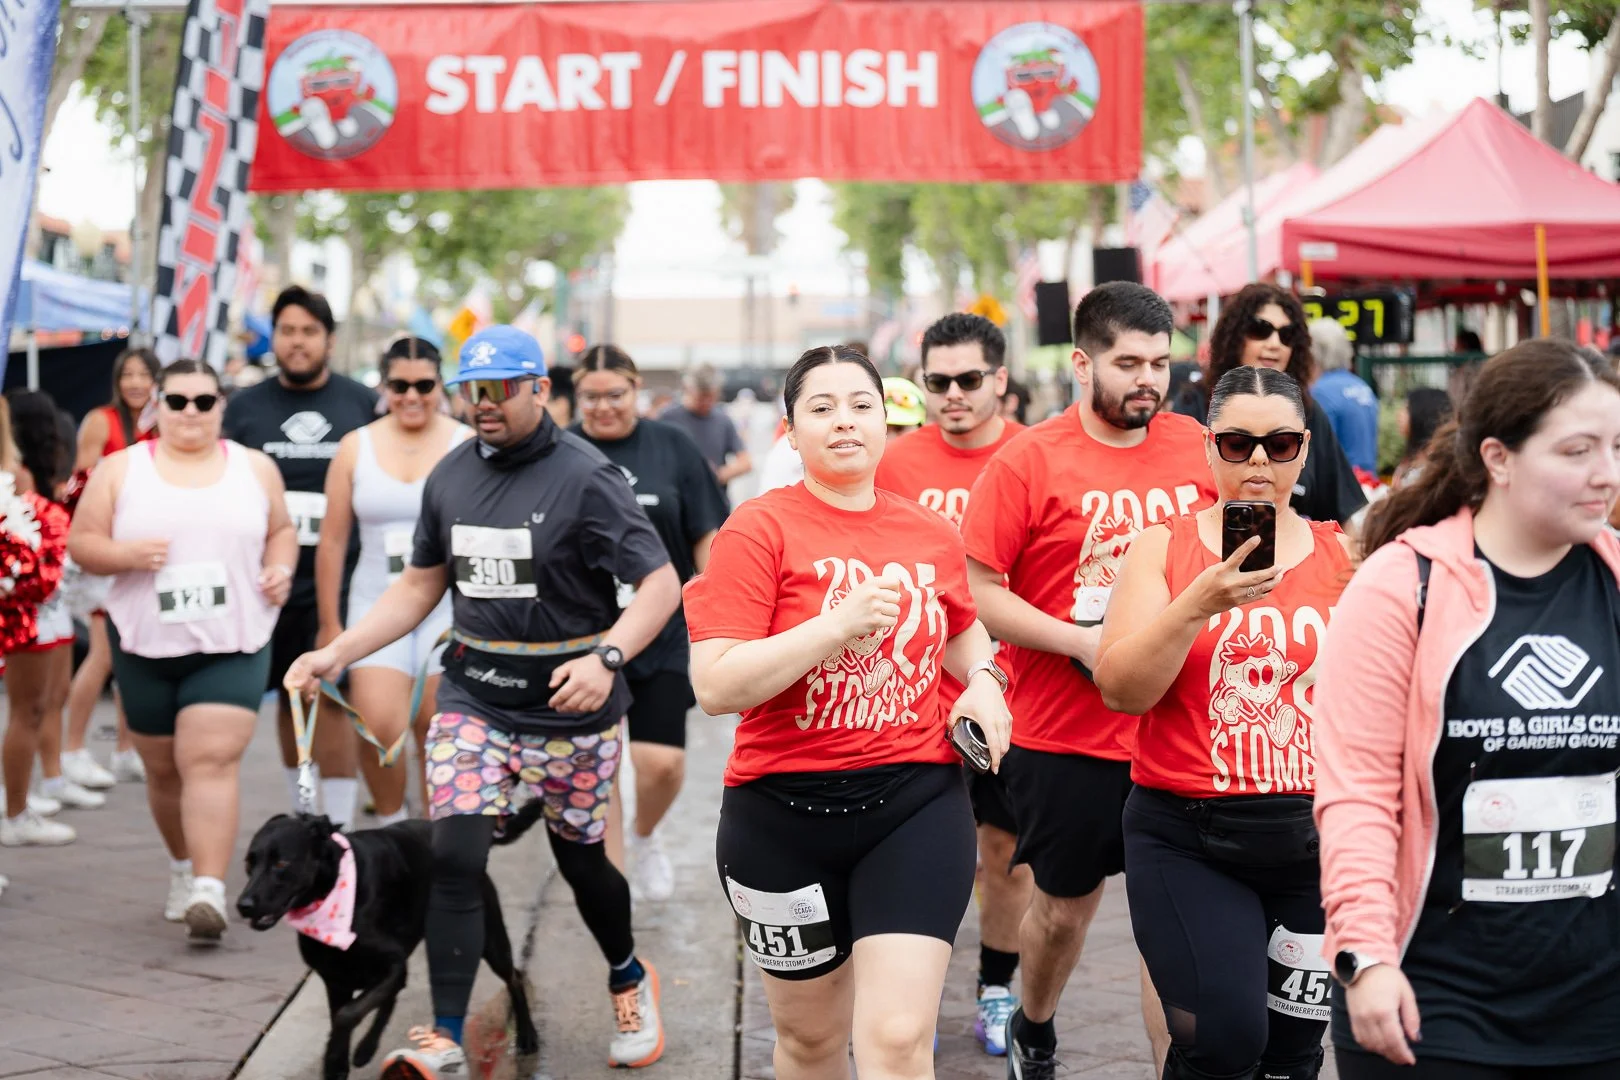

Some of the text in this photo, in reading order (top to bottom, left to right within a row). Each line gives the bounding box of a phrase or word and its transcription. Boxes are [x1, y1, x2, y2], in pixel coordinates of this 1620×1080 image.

[425, 48, 939, 114] START / FINISH
[468, 557, 516, 585] 390
[794, 669, 898, 733] STOMP
[1447, 718, 1505, 738] BOYS
[1507, 716, 1526, 736] &
[1527, 714, 1587, 735] GIRLS
[1482, 733, 1618, 752] OF GARDEN GROVE
[1210, 721, 1318, 794] STOMP
[1502, 828, 1586, 880] 117
[1496, 885, 1550, 896] STRAWBERRY
[1553, 884, 1580, 894] STOMP
[749, 921, 809, 957] 451
[785, 959, 806, 968] STOMP
[807, 956, 817, 965] 5K
[1274, 1000, 1315, 1016] STRAWBERRY
